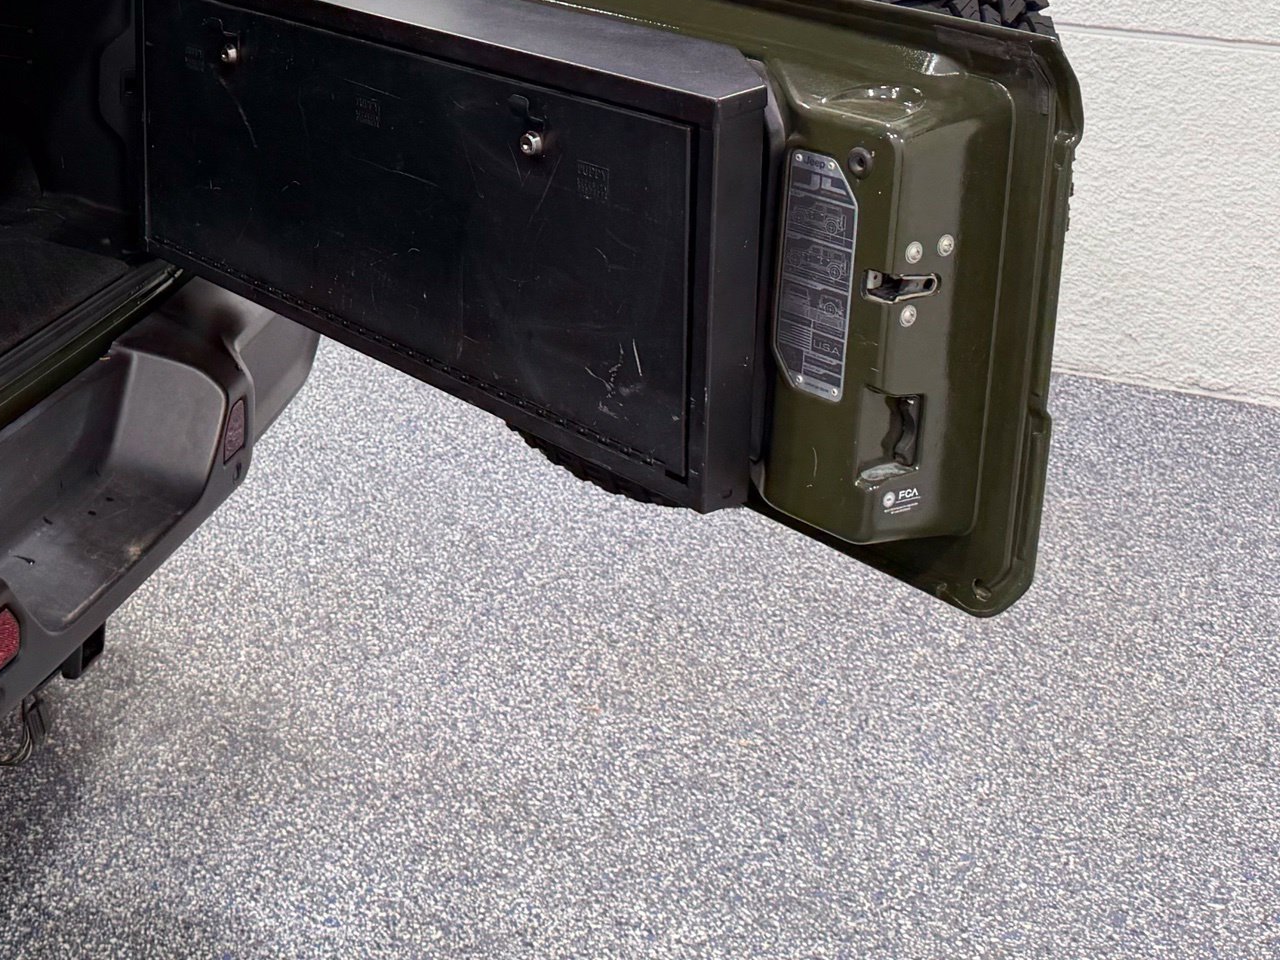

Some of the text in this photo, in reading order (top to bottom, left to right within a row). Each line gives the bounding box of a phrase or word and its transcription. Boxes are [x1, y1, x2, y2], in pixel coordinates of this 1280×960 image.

[803, 155, 827, 170] Jeep
[792, 172, 848, 196] JL
[898, 487, 919, 500] FCA
